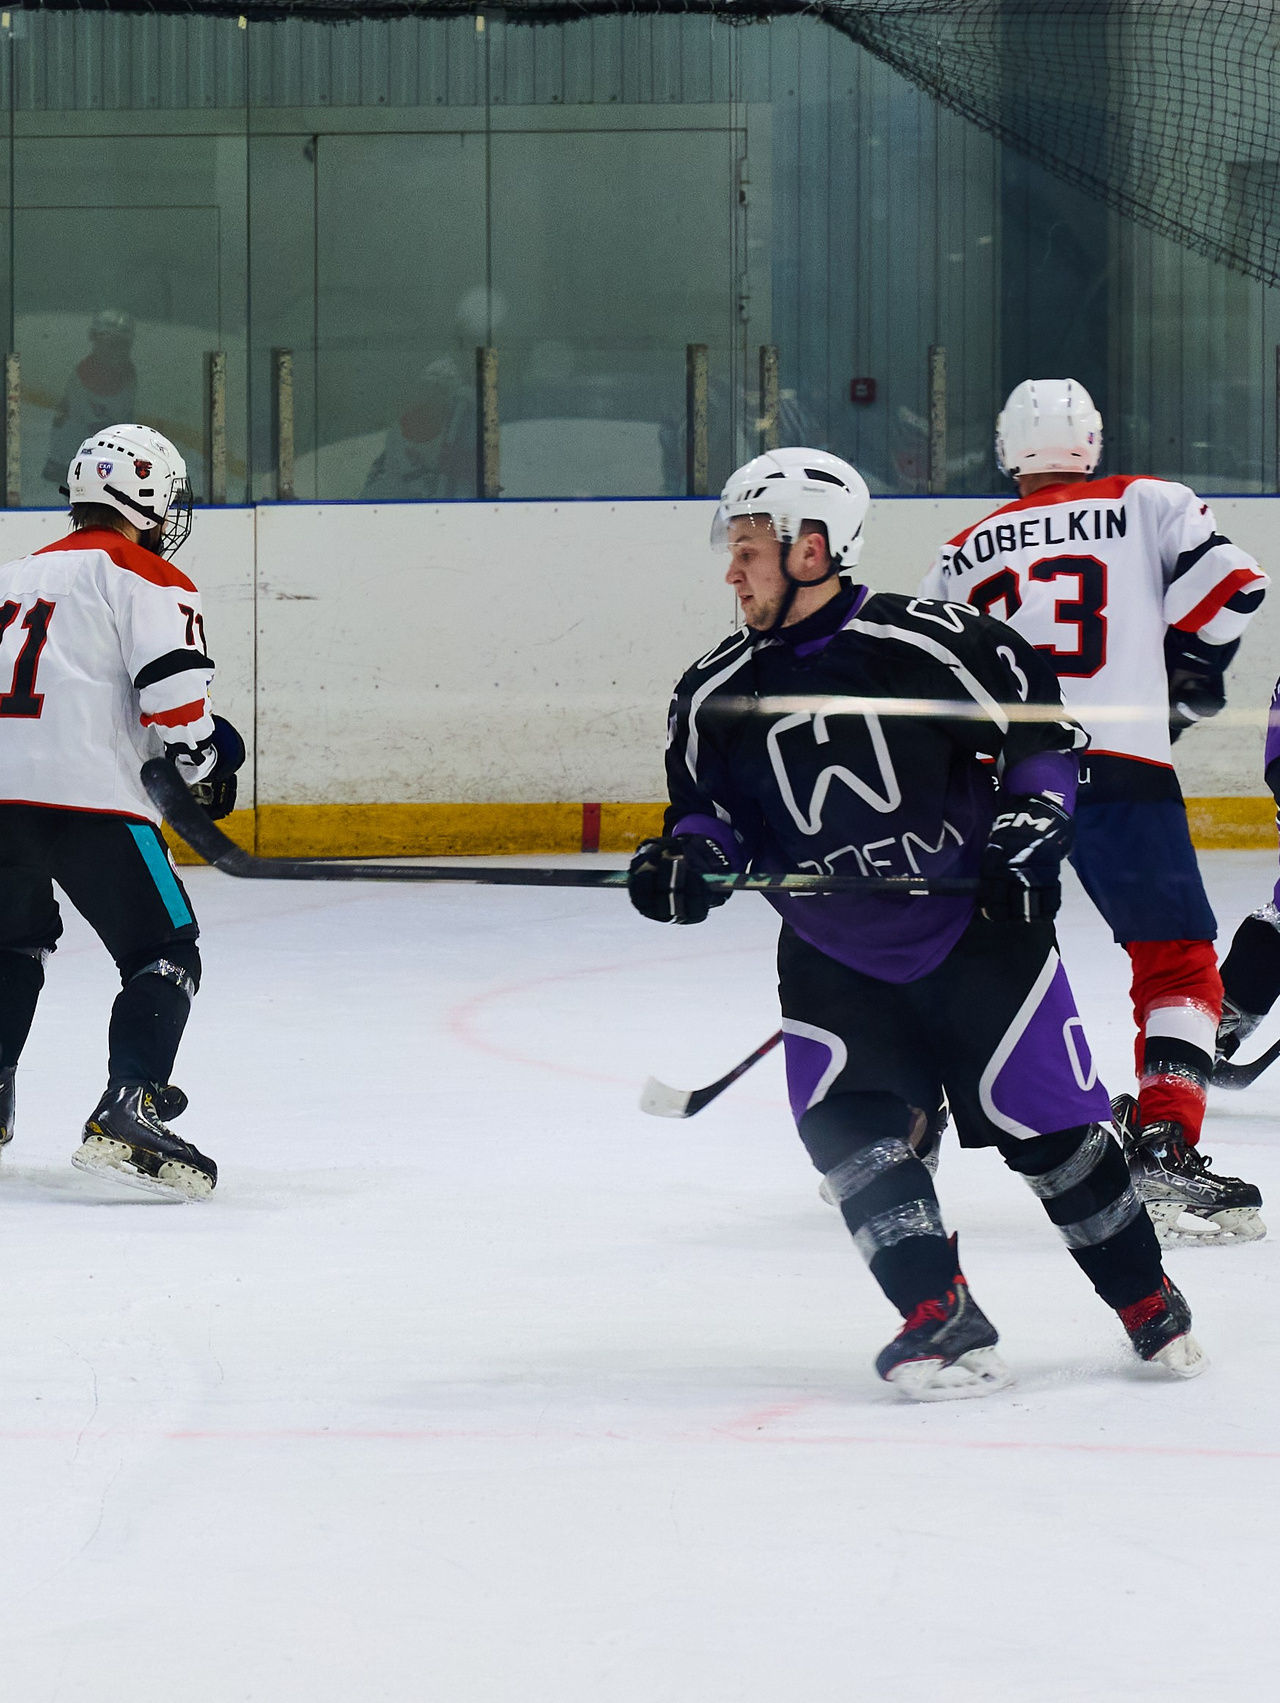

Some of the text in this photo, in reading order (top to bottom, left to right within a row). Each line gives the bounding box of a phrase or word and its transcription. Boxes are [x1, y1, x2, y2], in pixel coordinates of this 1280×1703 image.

[74, 461, 82, 480] 4
[177, 602, 208, 658] 71
[996, 645, 1029, 702] 3
[989, 812, 1056, 839] CM
[705, 839, 730, 866] CCM
[1143, 1165, 1218, 1201] VAPOR
